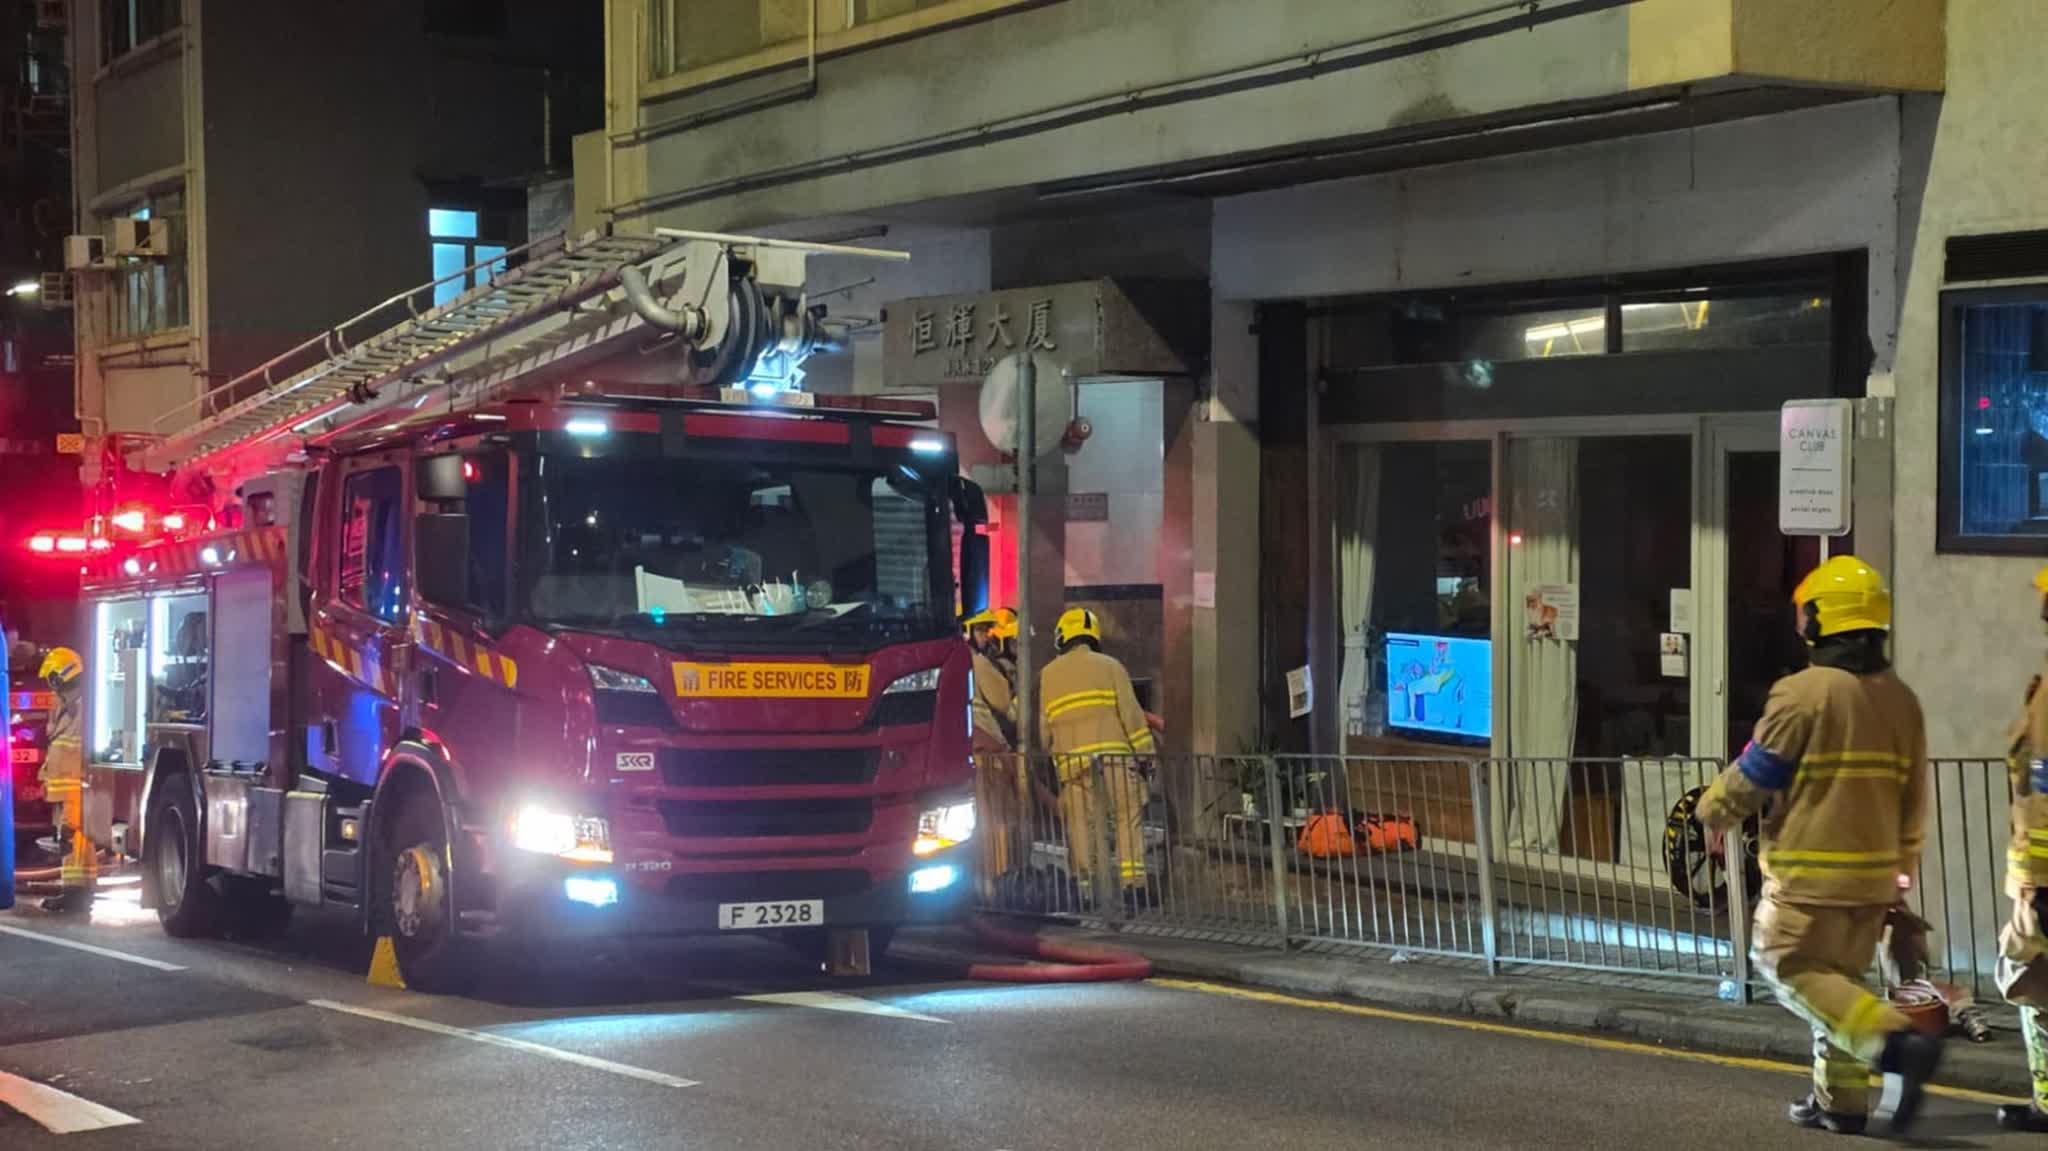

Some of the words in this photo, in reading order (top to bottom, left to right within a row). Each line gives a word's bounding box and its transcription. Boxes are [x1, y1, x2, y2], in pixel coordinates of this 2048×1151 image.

[708, 670, 748, 690] FIRE
[752, 670, 837, 690] SERVICES
[731, 905, 745, 925] F
[755, 903, 813, 925] 2328
